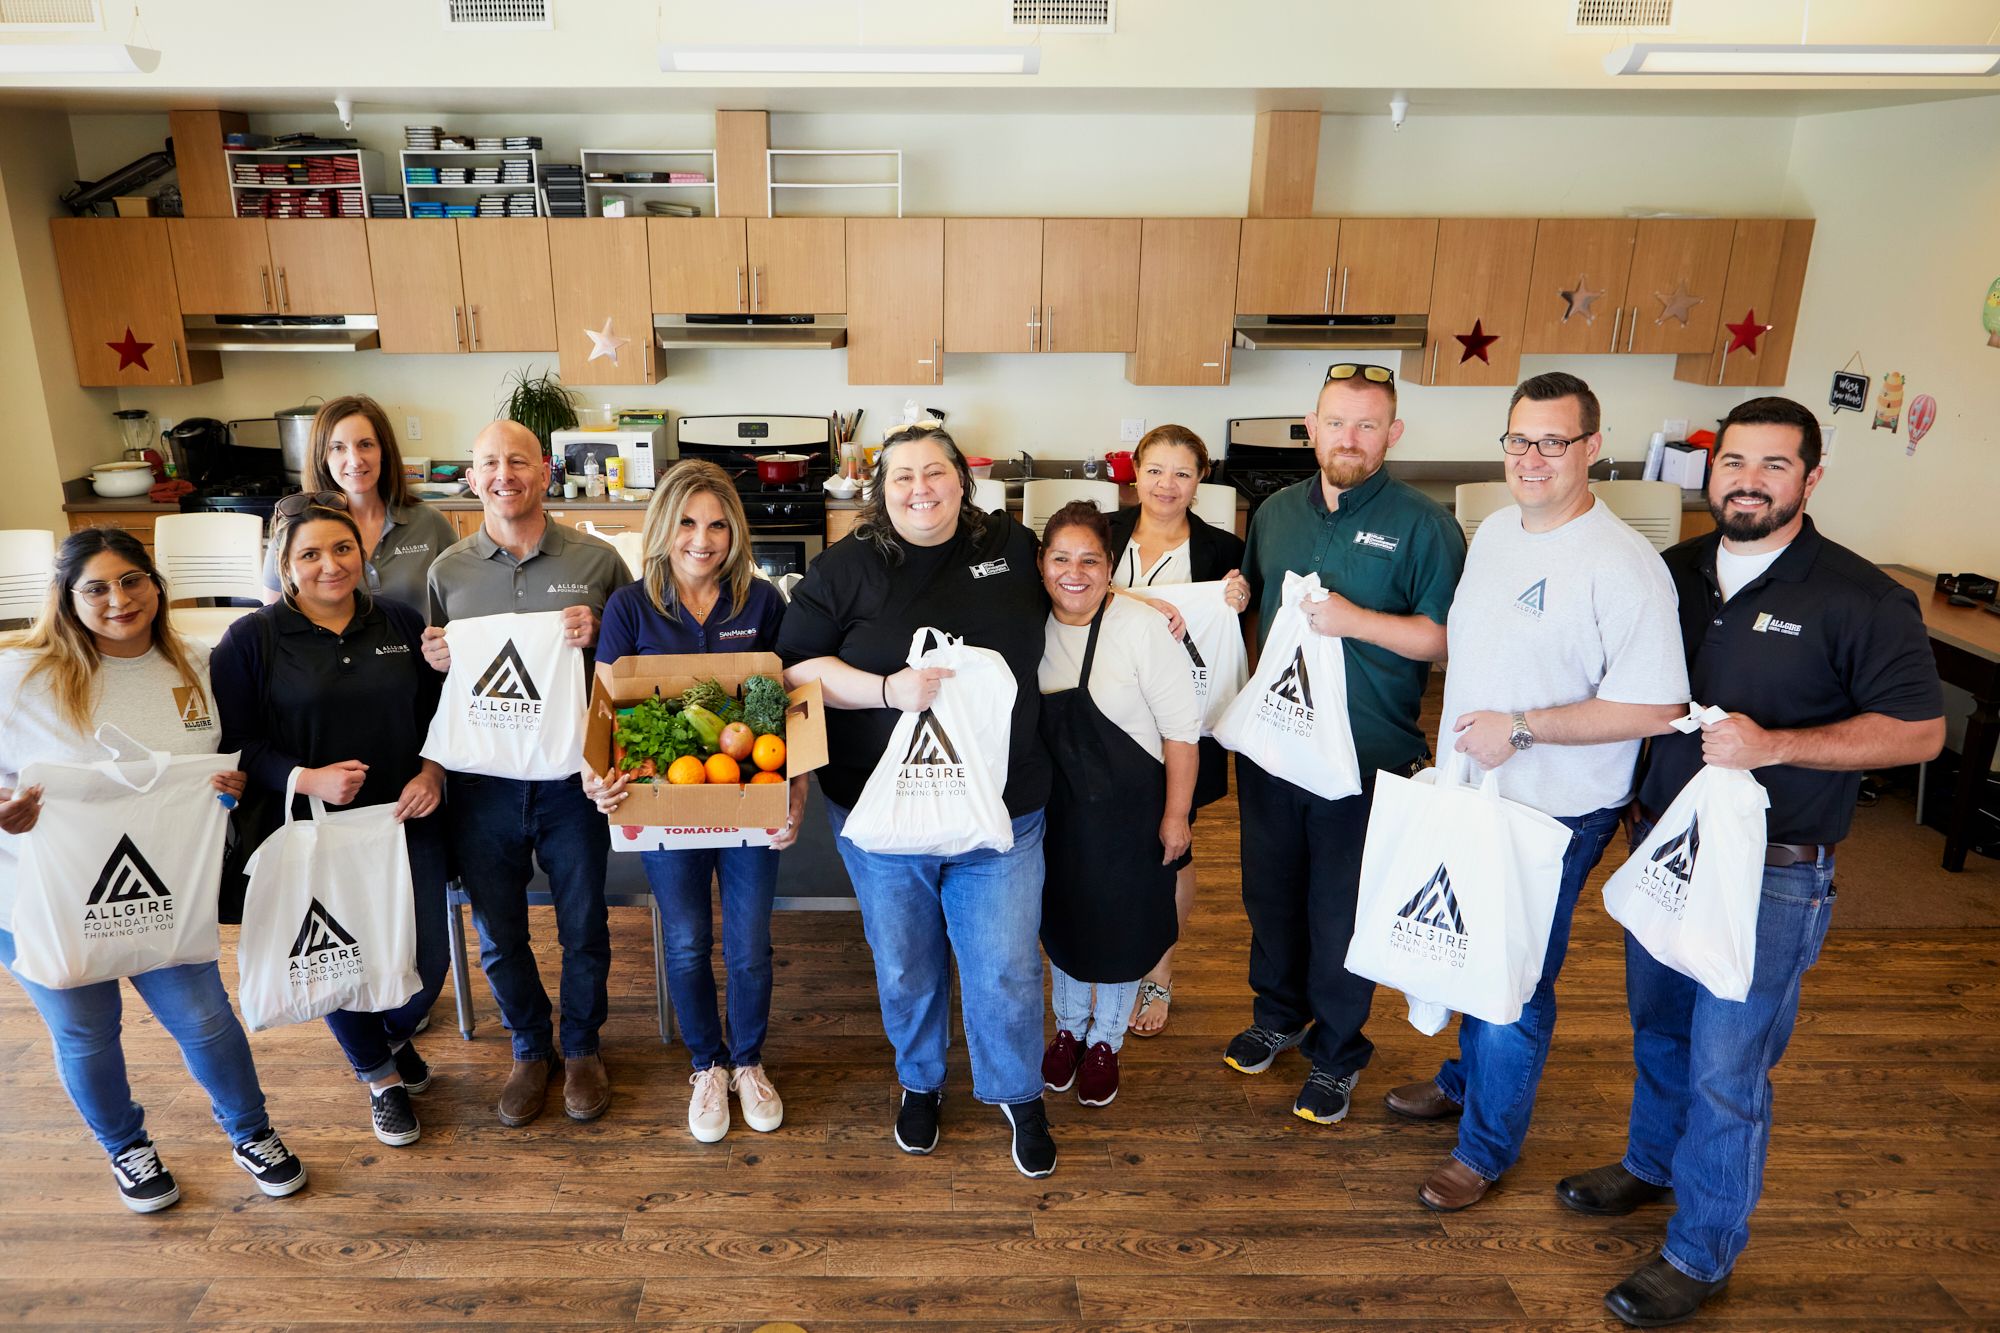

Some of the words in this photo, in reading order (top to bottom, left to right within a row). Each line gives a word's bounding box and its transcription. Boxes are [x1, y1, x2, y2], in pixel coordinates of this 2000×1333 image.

[1770, 619, 1802, 632] ALLGIRE
[470, 700, 541, 714] ALLGIRE
[184, 720, 212, 729] ALLGIRE
[1261, 705, 1313, 730] OUNTION
[1295, 728, 1311, 738] YOU
[896, 789, 930, 797] HINKING
[948, 789, 966, 797] YOU
[664, 827, 739, 835] TOMATOES
[85, 899, 172, 920] ALLGIRE
[84, 913, 174, 931] FOUNDATION
[85, 928, 134, 939] THINKING
[138, 925, 150, 934] OF
[154, 922, 174, 931] YOU
[1394, 920, 1468, 951] ALLGIRE
[1391, 931, 1466, 960] FOUNDATION
[289, 946, 361, 971] ALLGIRE
[289, 957, 363, 980] FOUNDATION
[332, 972, 343, 980] OF
[348, 966, 364, 976] YOU
